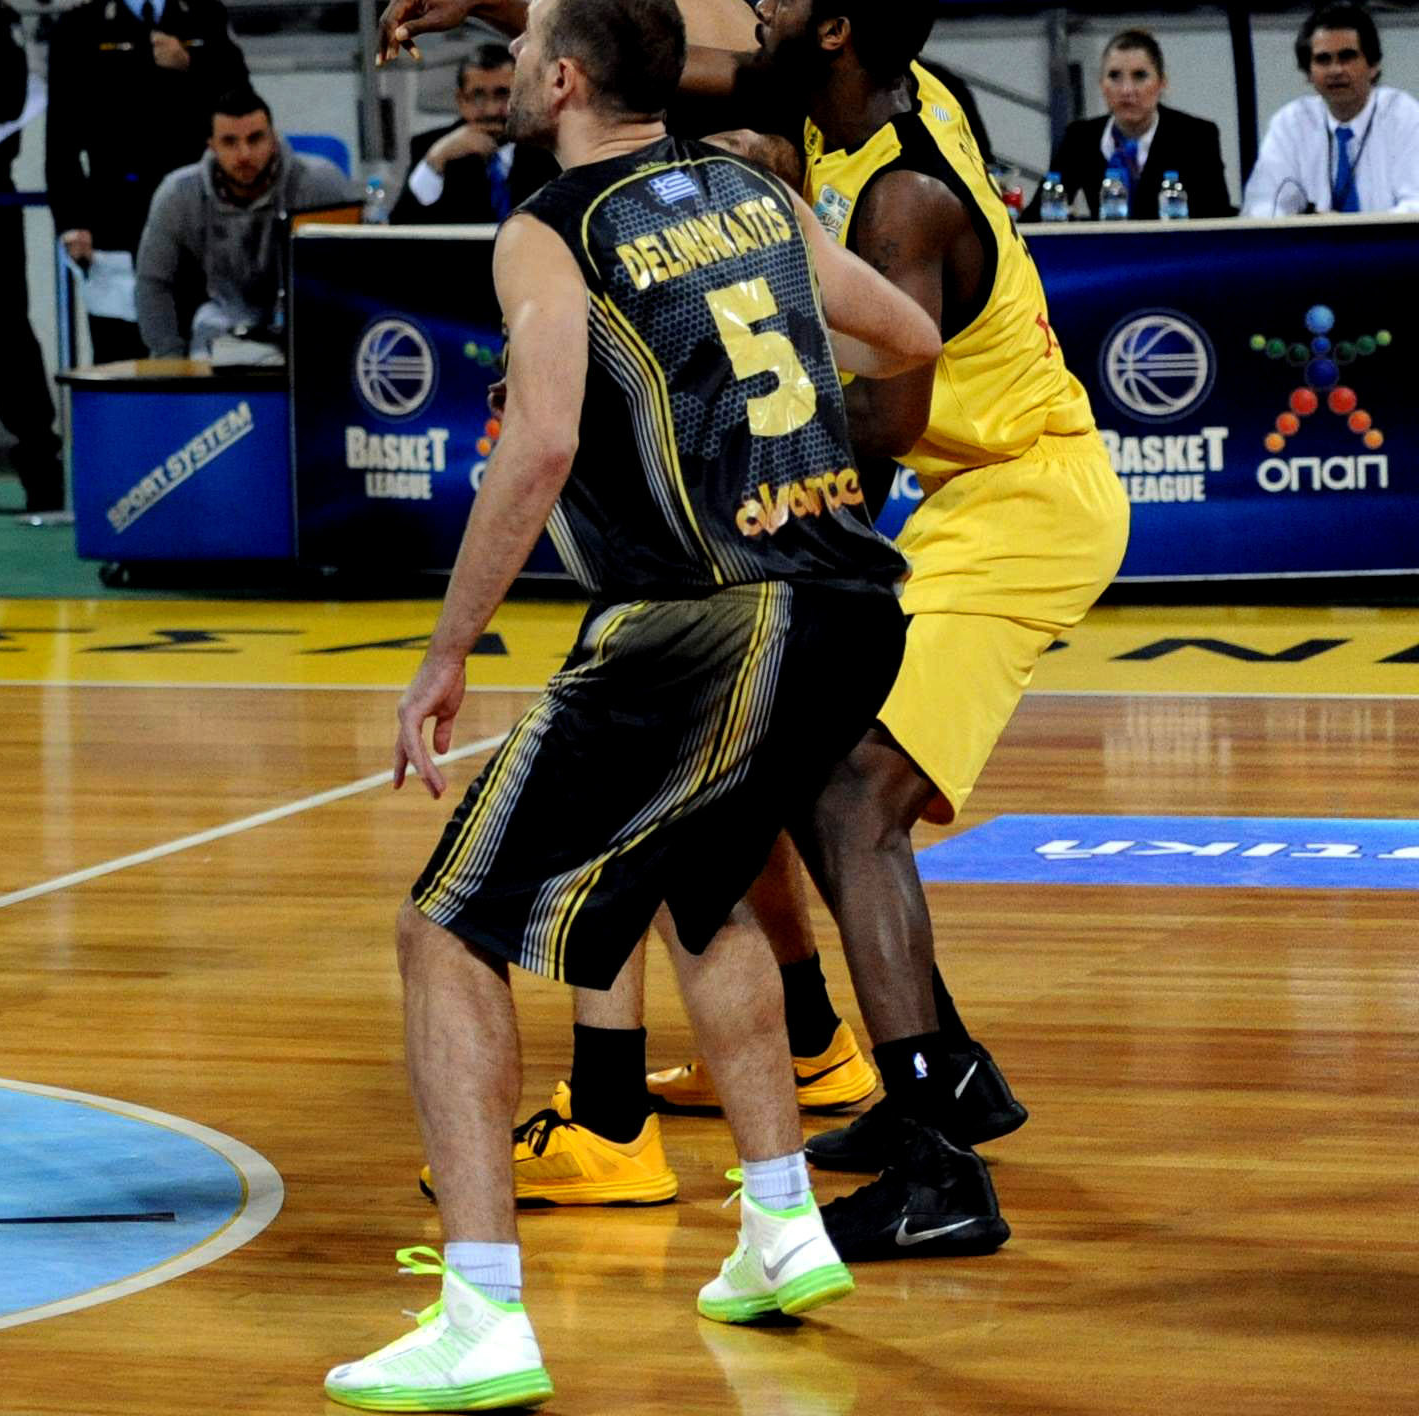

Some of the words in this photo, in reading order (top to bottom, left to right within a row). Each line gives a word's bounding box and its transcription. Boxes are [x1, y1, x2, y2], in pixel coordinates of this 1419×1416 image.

[704, 277, 817, 436] 5
[106, 465, 164, 529] SPORT
[163, 401, 254, 486] SYSTEM
[345, 425, 449, 473] BASKET
[1101, 426, 1229, 473] BASKET
[364, 473, 433, 500] LEAGUE
[1124, 473, 1206, 503] LEAGUE
